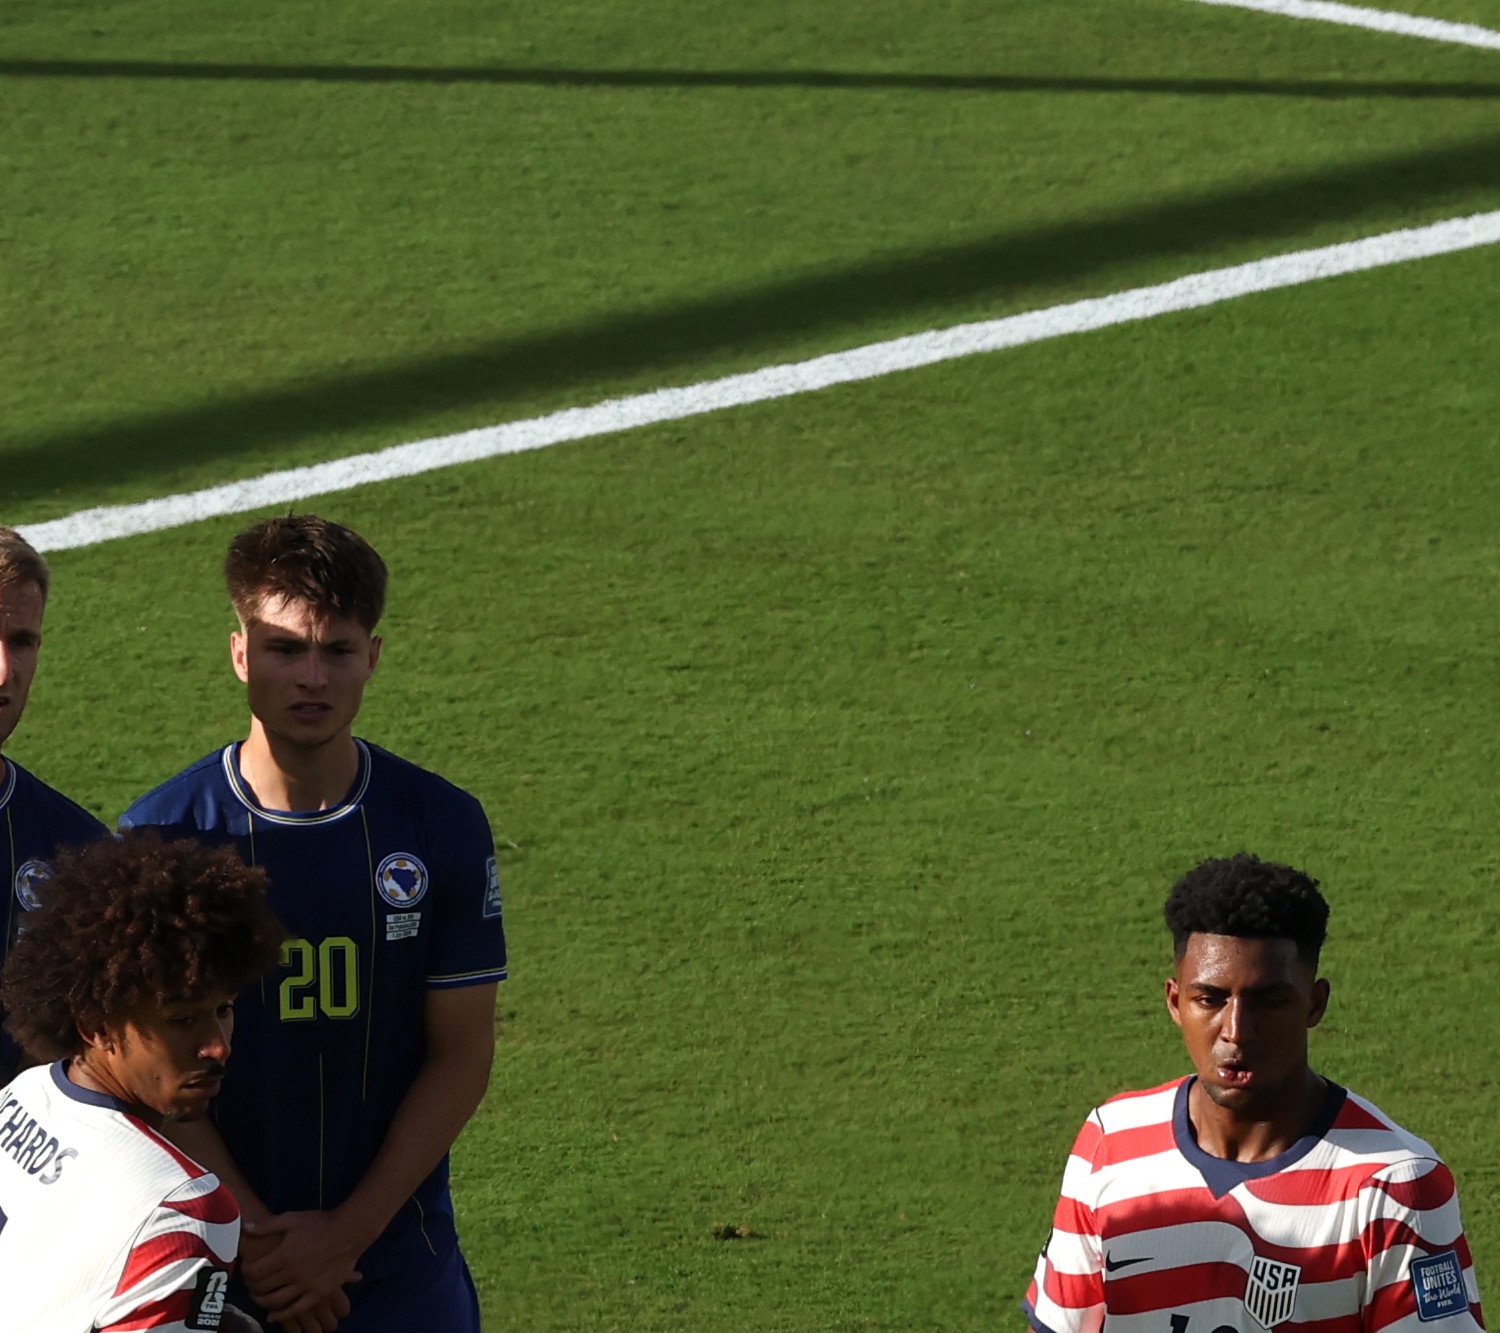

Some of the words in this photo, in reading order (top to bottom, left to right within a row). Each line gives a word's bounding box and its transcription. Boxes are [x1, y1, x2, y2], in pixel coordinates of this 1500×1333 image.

[279, 936, 359, 1021] 20
[1253, 1260, 1297, 1290] USA
[1421, 1260, 1455, 1277] FOOTBALL
[1423, 1270, 1457, 1291] UNITES
[1423, 1291, 1438, 1303] the
[1438, 1282, 1461, 1299] World
